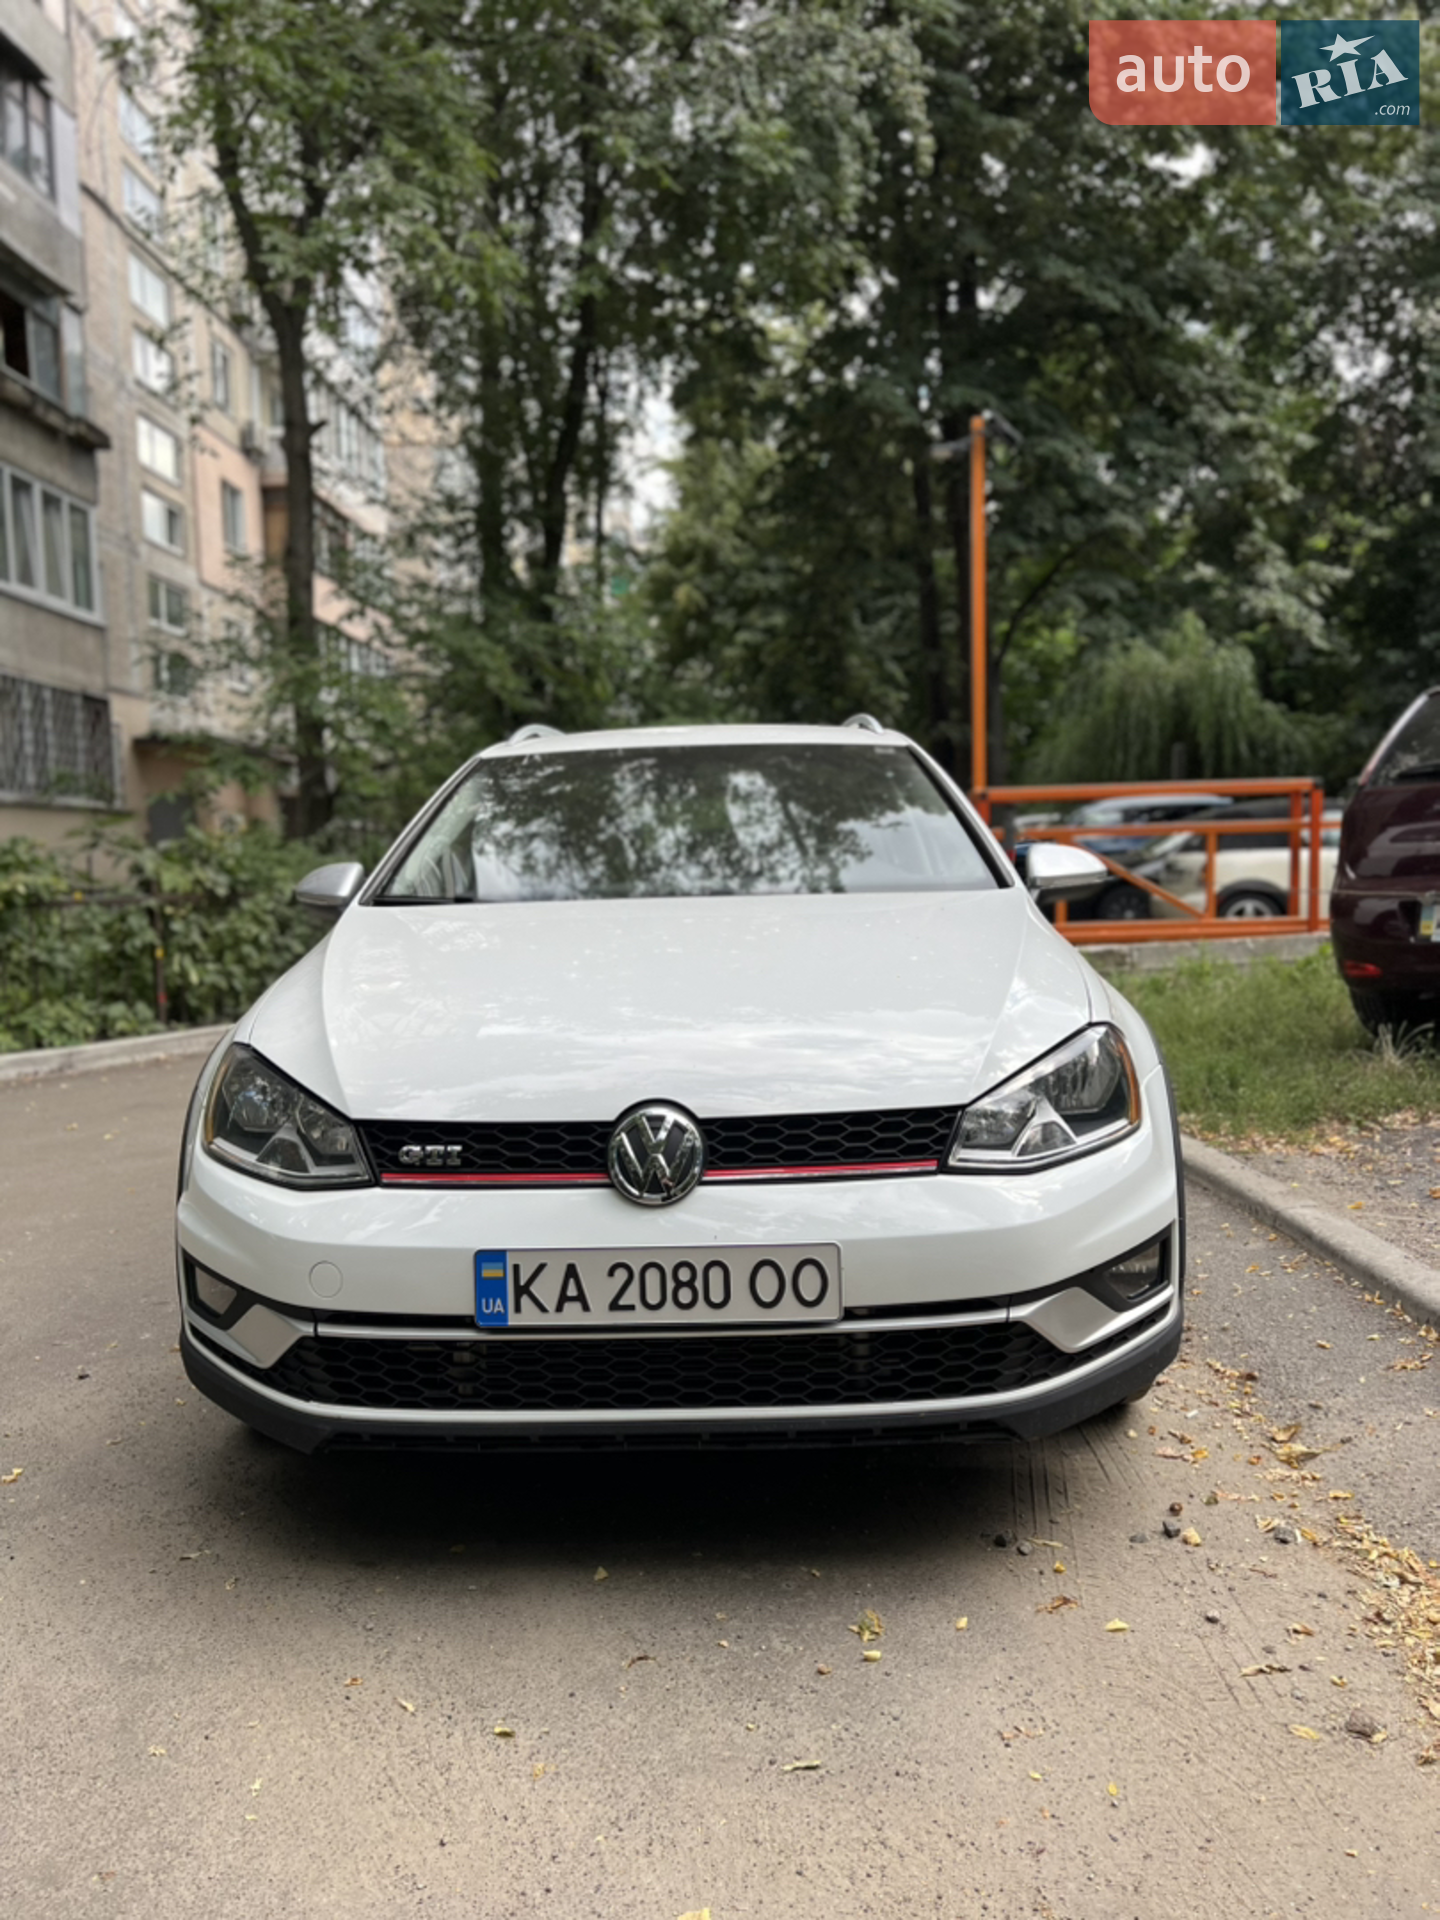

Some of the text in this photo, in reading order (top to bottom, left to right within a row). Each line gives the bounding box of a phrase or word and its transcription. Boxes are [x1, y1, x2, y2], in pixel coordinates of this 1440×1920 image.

[398, 1144, 463, 1166] GTI
[512, 1257, 829, 1314] KA 2080 OO
[482, 1298, 505, 1314] UA
